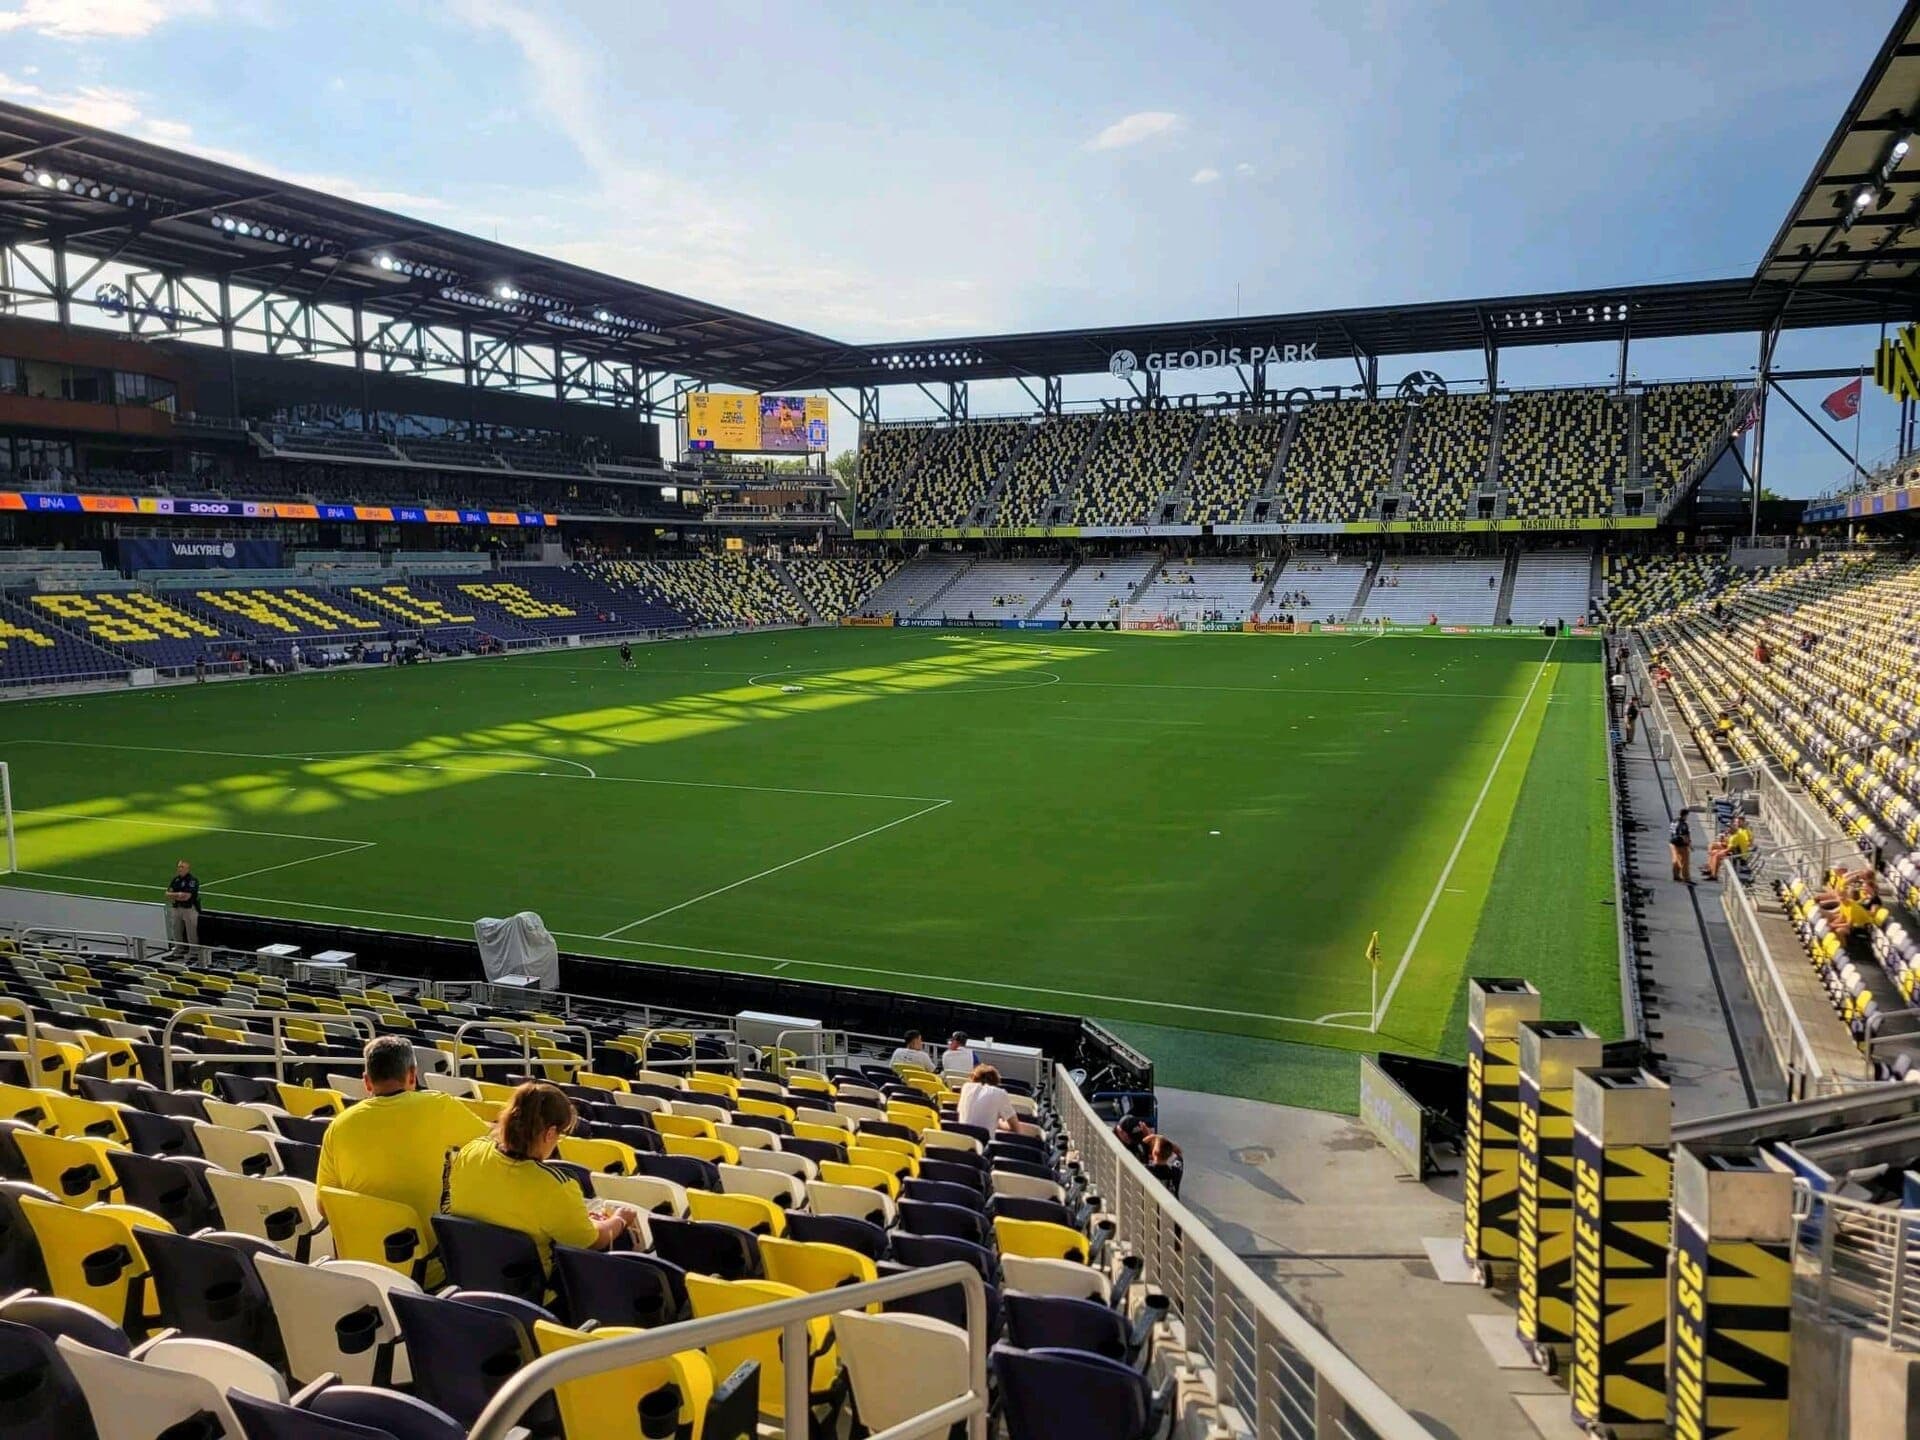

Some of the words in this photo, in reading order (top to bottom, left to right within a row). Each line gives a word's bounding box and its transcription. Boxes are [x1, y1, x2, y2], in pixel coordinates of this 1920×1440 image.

[1146, 348, 1242, 373] GEODIS
[1250, 342, 1318, 366] PARK
[40, 497, 66, 509] BNA
[190, 503, 230, 514] 30:00
[327, 508, 345, 518] BNA
[401, 511, 417, 520] BNA
[466, 513, 481, 522] BNA
[1410, 521, 1450, 531] NASHVILLE
[1454, 521, 1466, 531] SC
[1520, 519, 1567, 530] NASHVILLE
[1569, 519, 1581, 529] SC
[172, 543, 222, 556] VALKYRIE
[911, 619, 941, 627] HYUNDAI
[1254, 622, 1292, 633] Continental
[1469, 1052, 1483, 1099] SC
[1520, 1102, 1538, 1154] SC
[1577, 1158, 1600, 1219] SC
[1518, 1153, 1538, 1340] NASHVILLE
[1678, 1249, 1704, 1322] SC
[1574, 1216, 1600, 1418] NASHVILLE
[1675, 1314, 1703, 1440] VILLE
